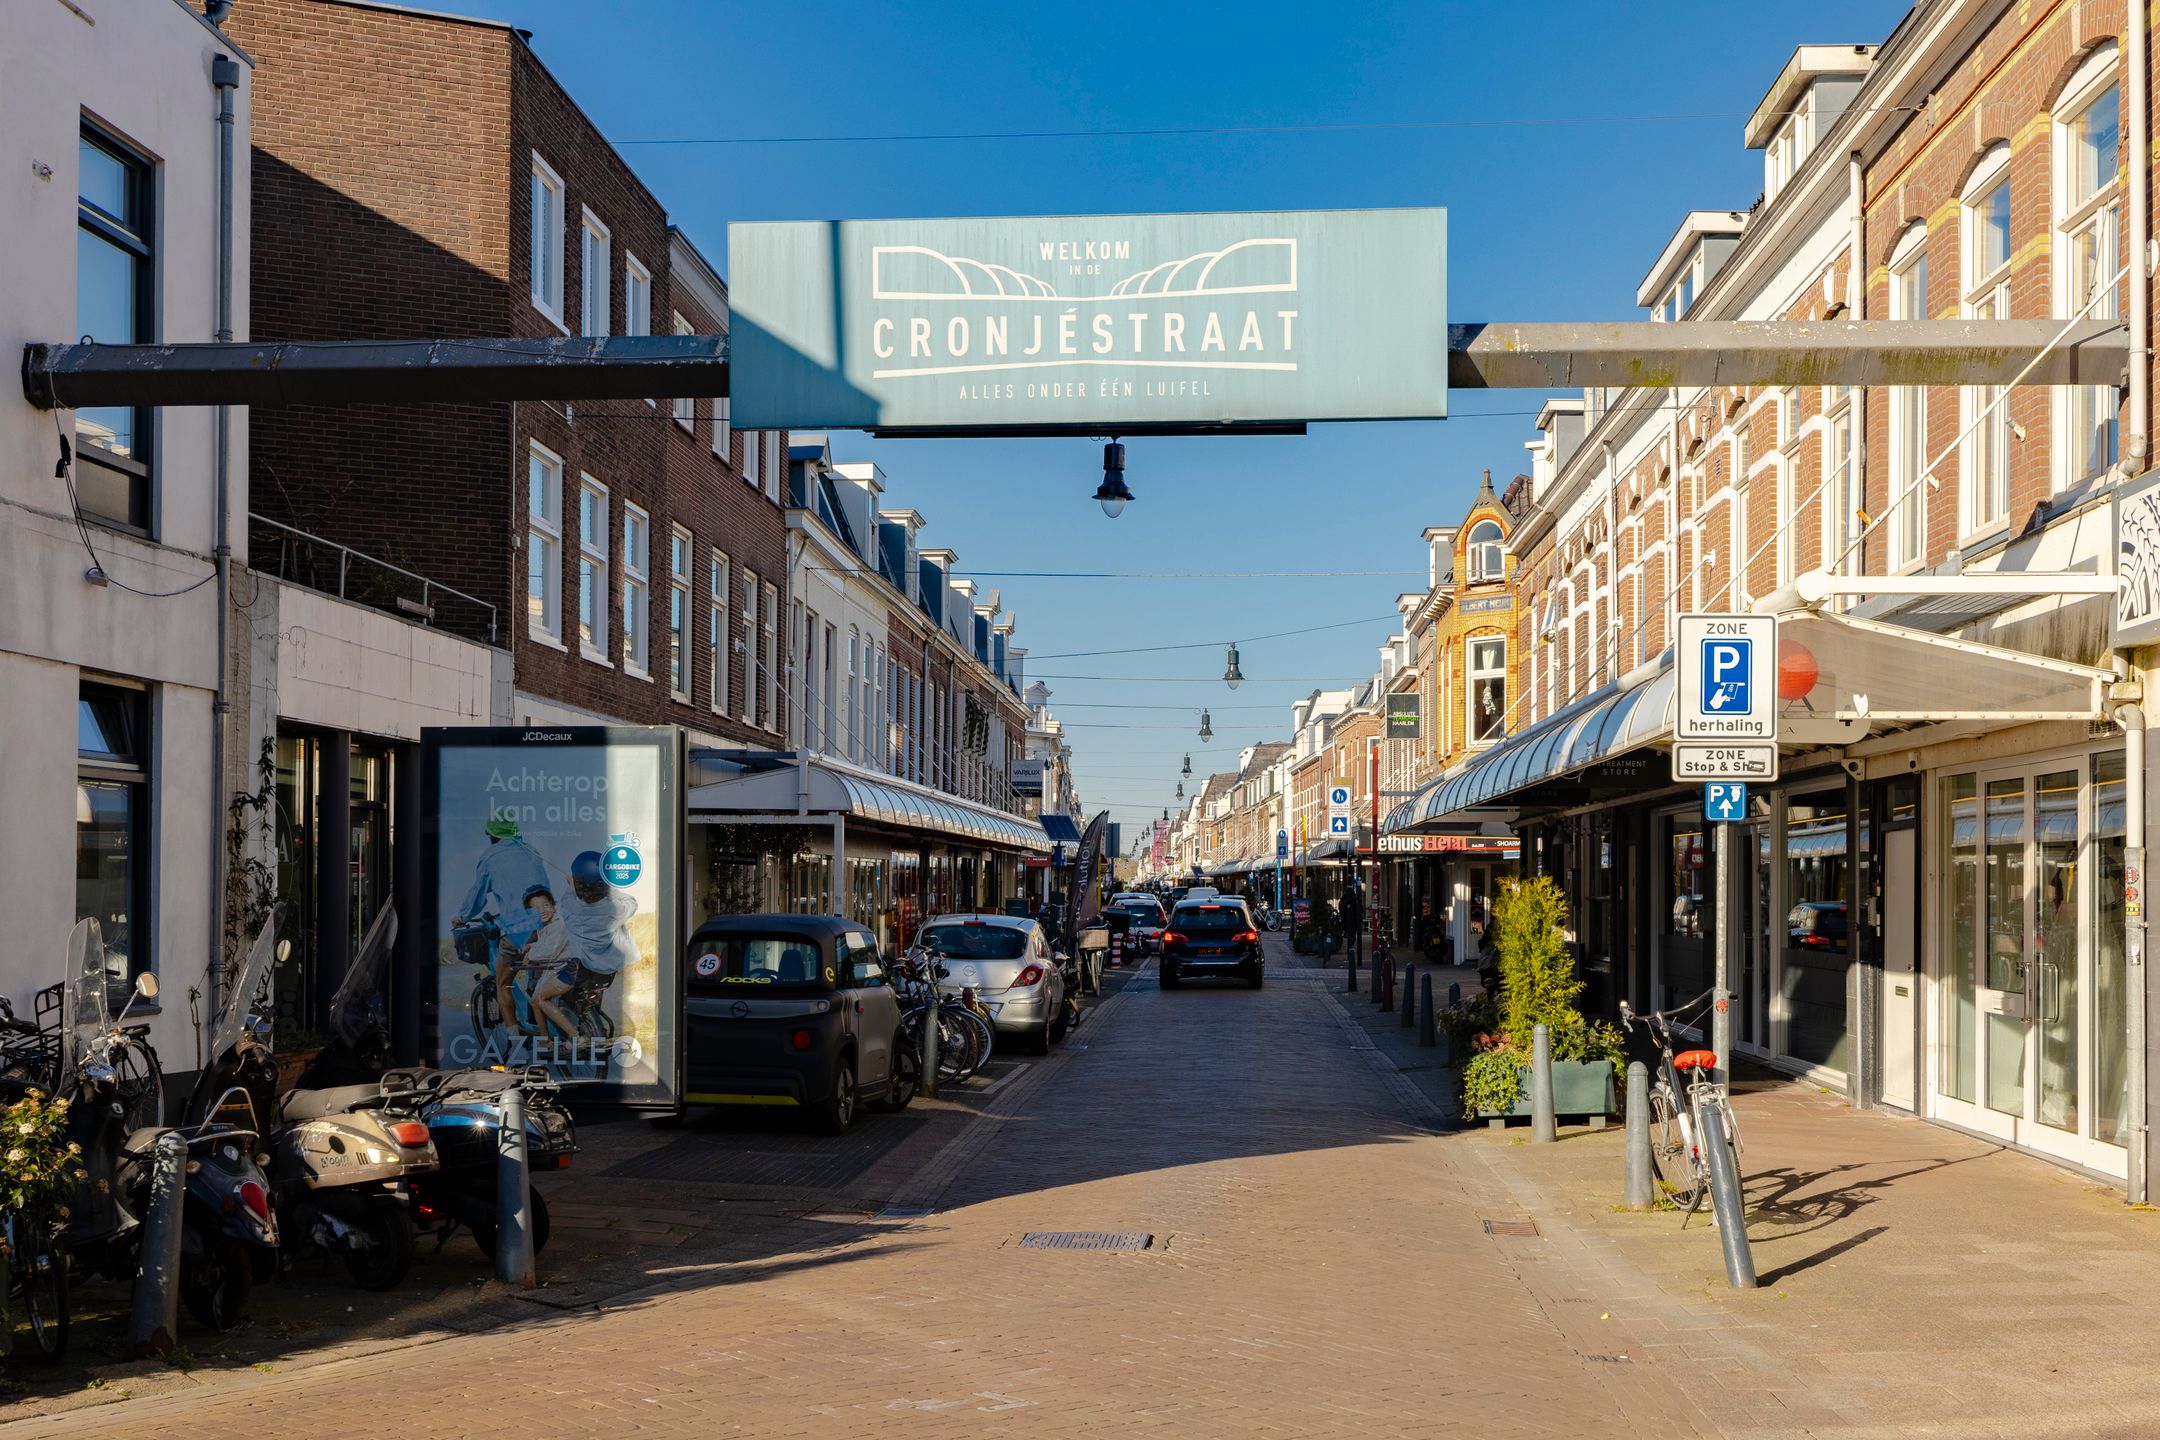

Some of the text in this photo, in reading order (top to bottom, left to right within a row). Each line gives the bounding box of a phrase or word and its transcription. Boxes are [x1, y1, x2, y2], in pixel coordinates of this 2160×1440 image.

[1040, 240, 1130, 260] WELKOM
[1069, 264, 1101, 275] IN DE
[872, 307, 1298, 358] CRONJÉSTRAAT
[959, 378, 1211, 400] ALLES ONDER ÉÉN LUIFEL
[1706, 623, 1748, 635] ZONE
[1714, 646, 1740, 683] P
[1690, 719, 1763, 735] herhaling
[522, 731, 573, 741] JCDecaux
[1706, 750, 1746, 760] ZONE
[1686, 762, 1716, 773] Stop
[1719, 762, 1729, 772] &
[1733, 762, 1755, 772] Sh
[485, 767, 609, 800] Achterop
[1711, 786, 1725, 803] P
[490, 797, 607, 823] kan alles
[700, 959, 716, 970] 45
[450, 1034, 607, 1066] GAZELLE
